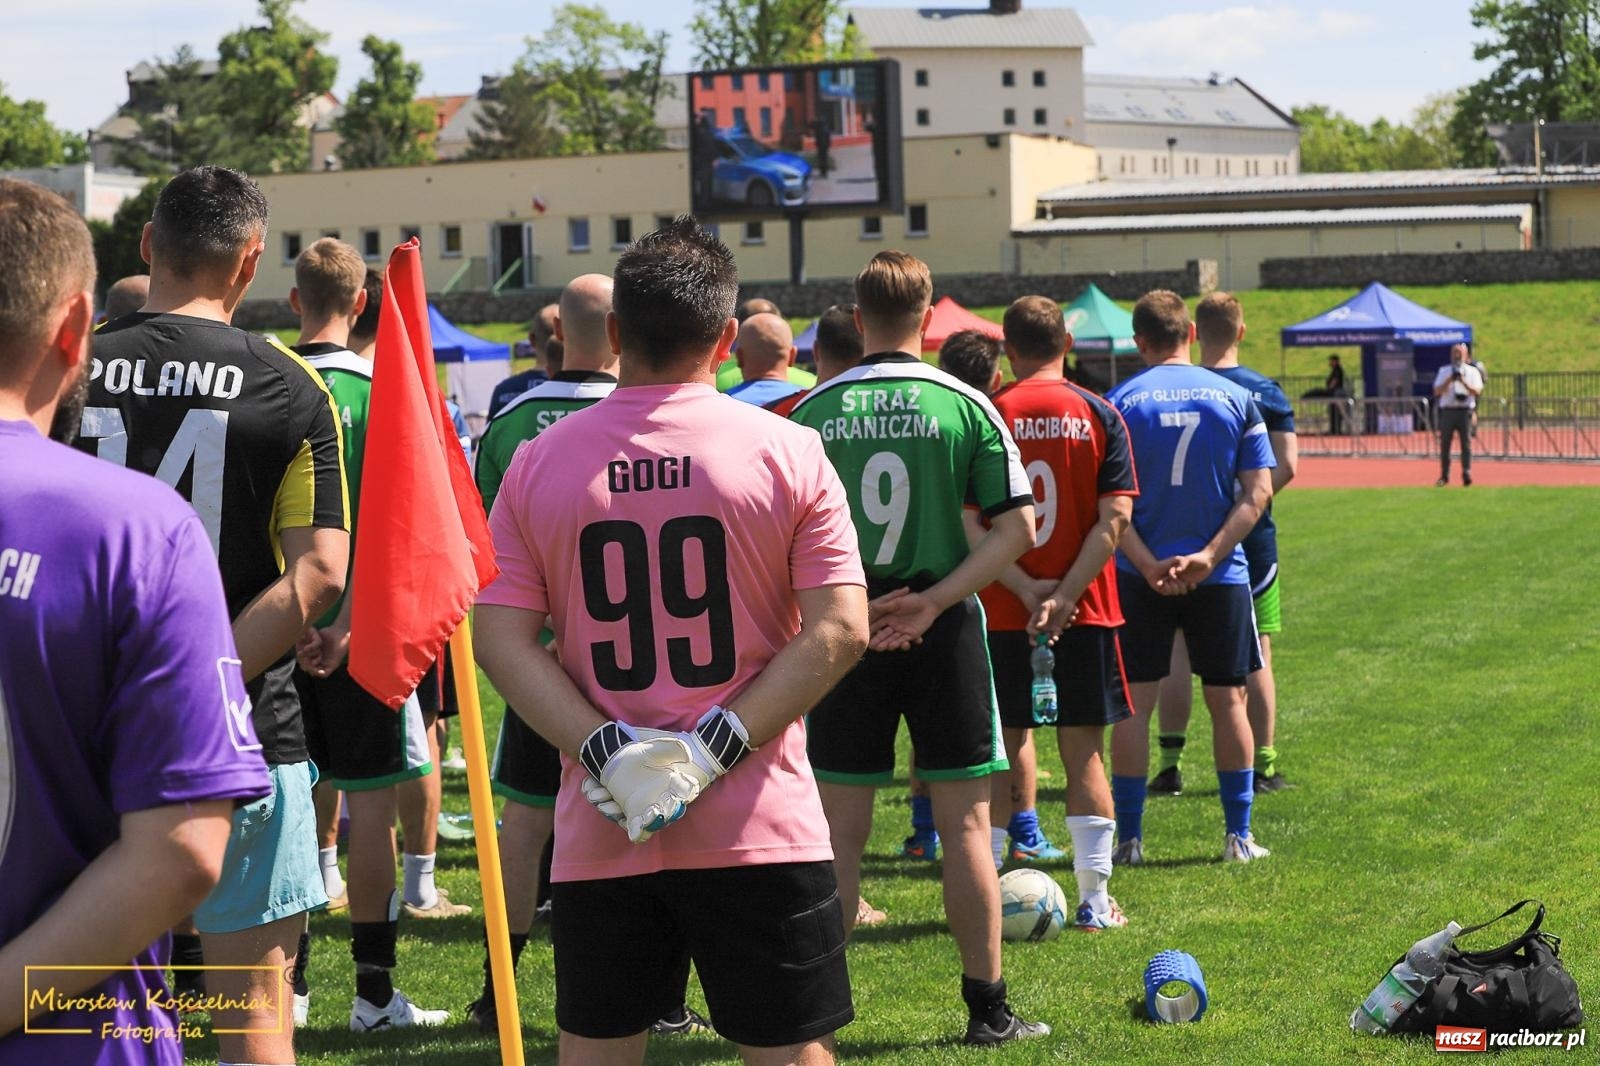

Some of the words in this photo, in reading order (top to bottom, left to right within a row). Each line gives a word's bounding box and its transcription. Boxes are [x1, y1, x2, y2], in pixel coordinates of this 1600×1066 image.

[89, 357, 244, 400] POLAND
[841, 385, 921, 412] STRAŻ
[822, 414, 940, 442] GRANICZNA
[1014, 410, 1092, 441] RACIBÓRZ
[1159, 411, 1201, 486] 7
[608, 455, 692, 493] GOGI
[861, 451, 911, 565] 9
[1024, 459, 1058, 549] 9
[579, 515, 737, 692] 99
